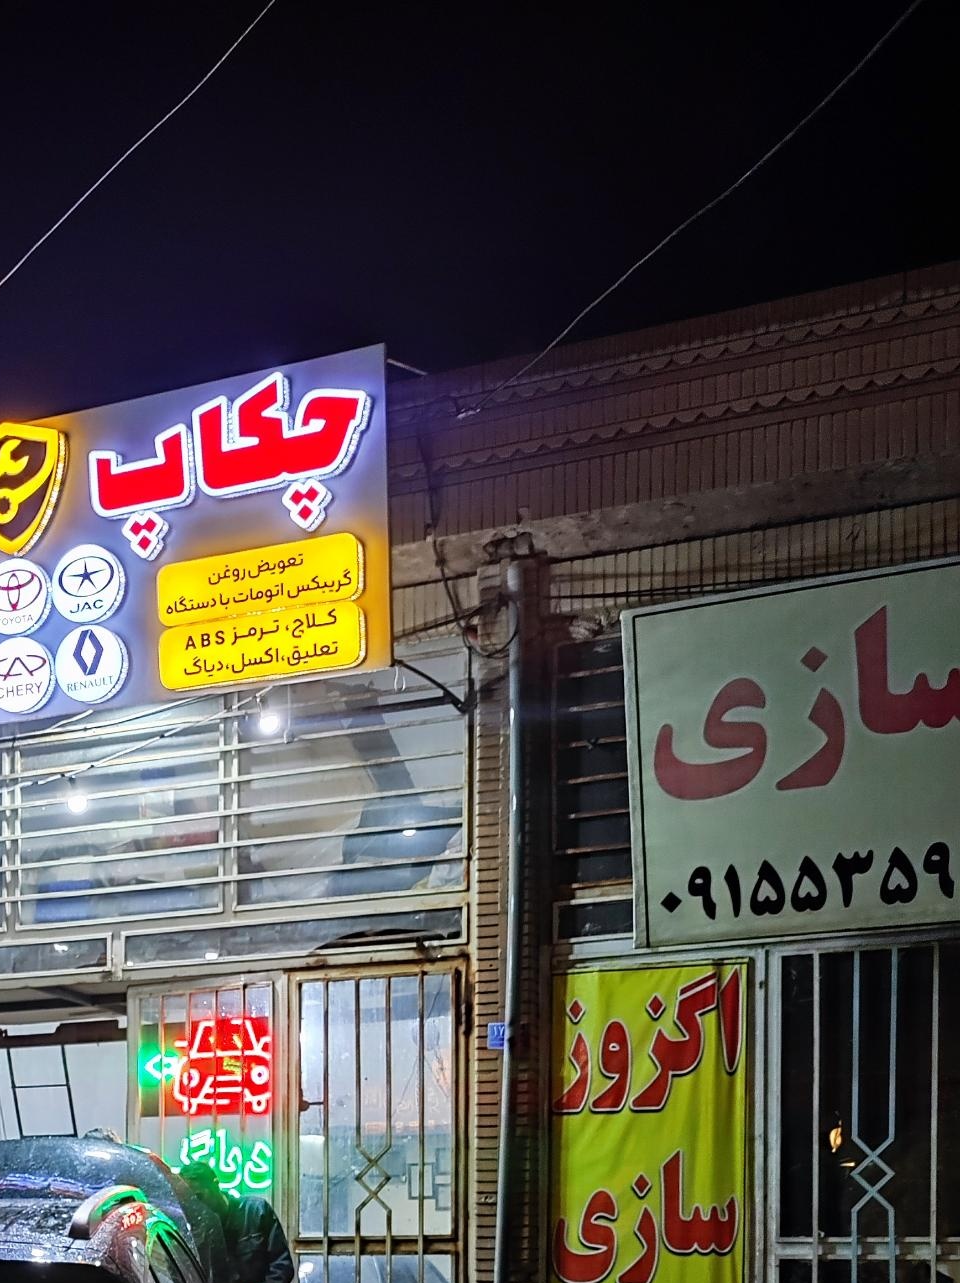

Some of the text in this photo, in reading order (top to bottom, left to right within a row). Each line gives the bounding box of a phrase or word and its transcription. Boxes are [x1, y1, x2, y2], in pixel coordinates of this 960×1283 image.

[89, 371, 372, 561] چکاپ
[208, 553, 304, 585] تعویض روغن
[219, 594, 229, 610] با
[233, 583, 284, 603] اتومات
[69, 599, 104, 614] JAC
[166, 596, 216, 615] دستگاه
[232, 620, 280, 645] ترمز
[184, 657, 223, 677] دیاگ
[66, 675, 114, 692] RENAULT
[654, 605, 960, 800] سازی
[660, 841, 955, 920] ۰۹۱۵۵۳۵۹
[552, 966, 741, 1113] اگزوز
